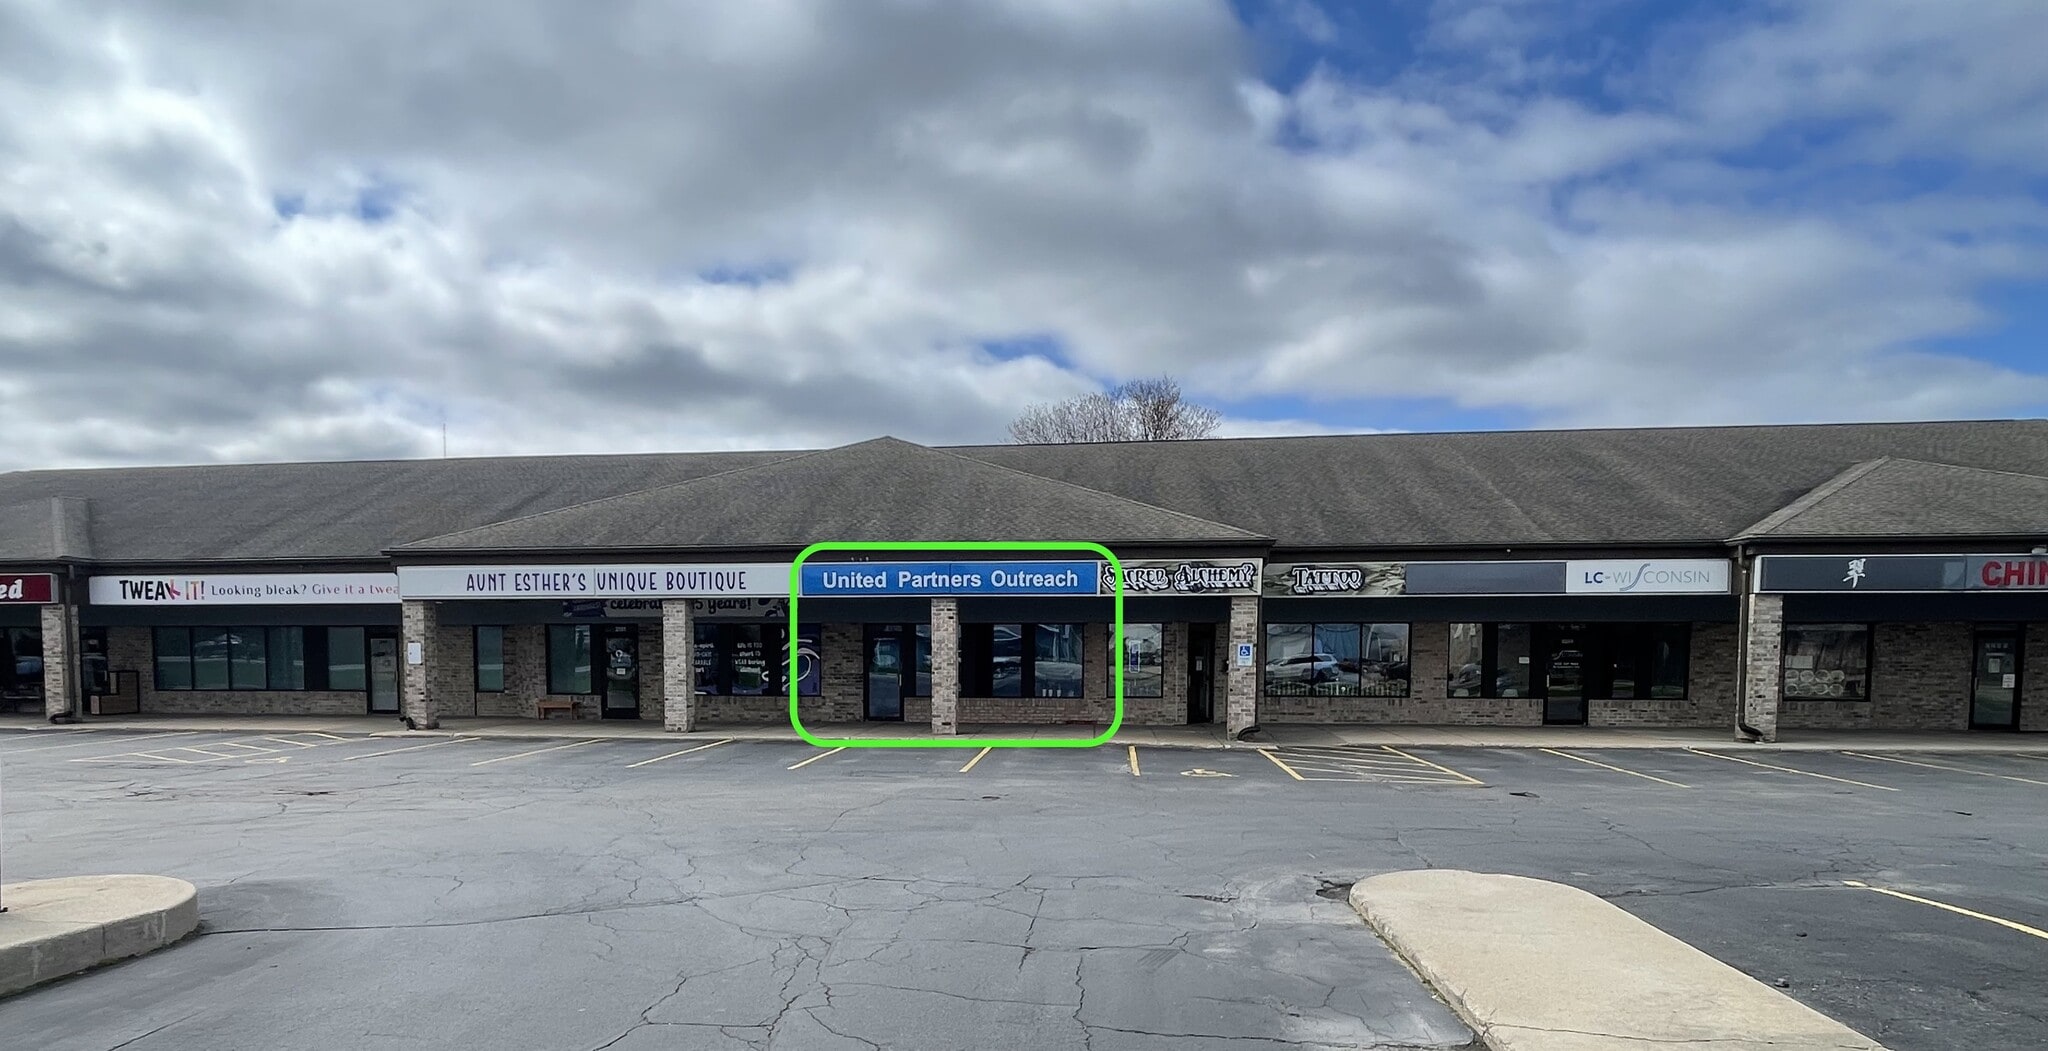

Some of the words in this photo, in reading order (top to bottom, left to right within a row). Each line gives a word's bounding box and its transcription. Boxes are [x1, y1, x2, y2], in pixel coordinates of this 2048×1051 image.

[466, 573, 506, 592] AUNT
[514, 572, 587, 592] ESTHER'S
[597, 571, 657, 592] UNIQUE
[665, 571, 747, 592] BOUTIQUE
[822, 571, 887, 589] United
[898, 570, 982, 588] Partners
[990, 569, 1078, 588] Outreach
[1103, 565, 1170, 591] SCRED
[119, 579, 180, 601] TWEAK
[185, 580, 205, 600] IT!
[211, 584, 261, 598] Looking
[266, 583, 307, 596] bleak?
[312, 583, 340, 595] Give
[345, 583, 353, 595] it
[358, 586, 365, 595] a
